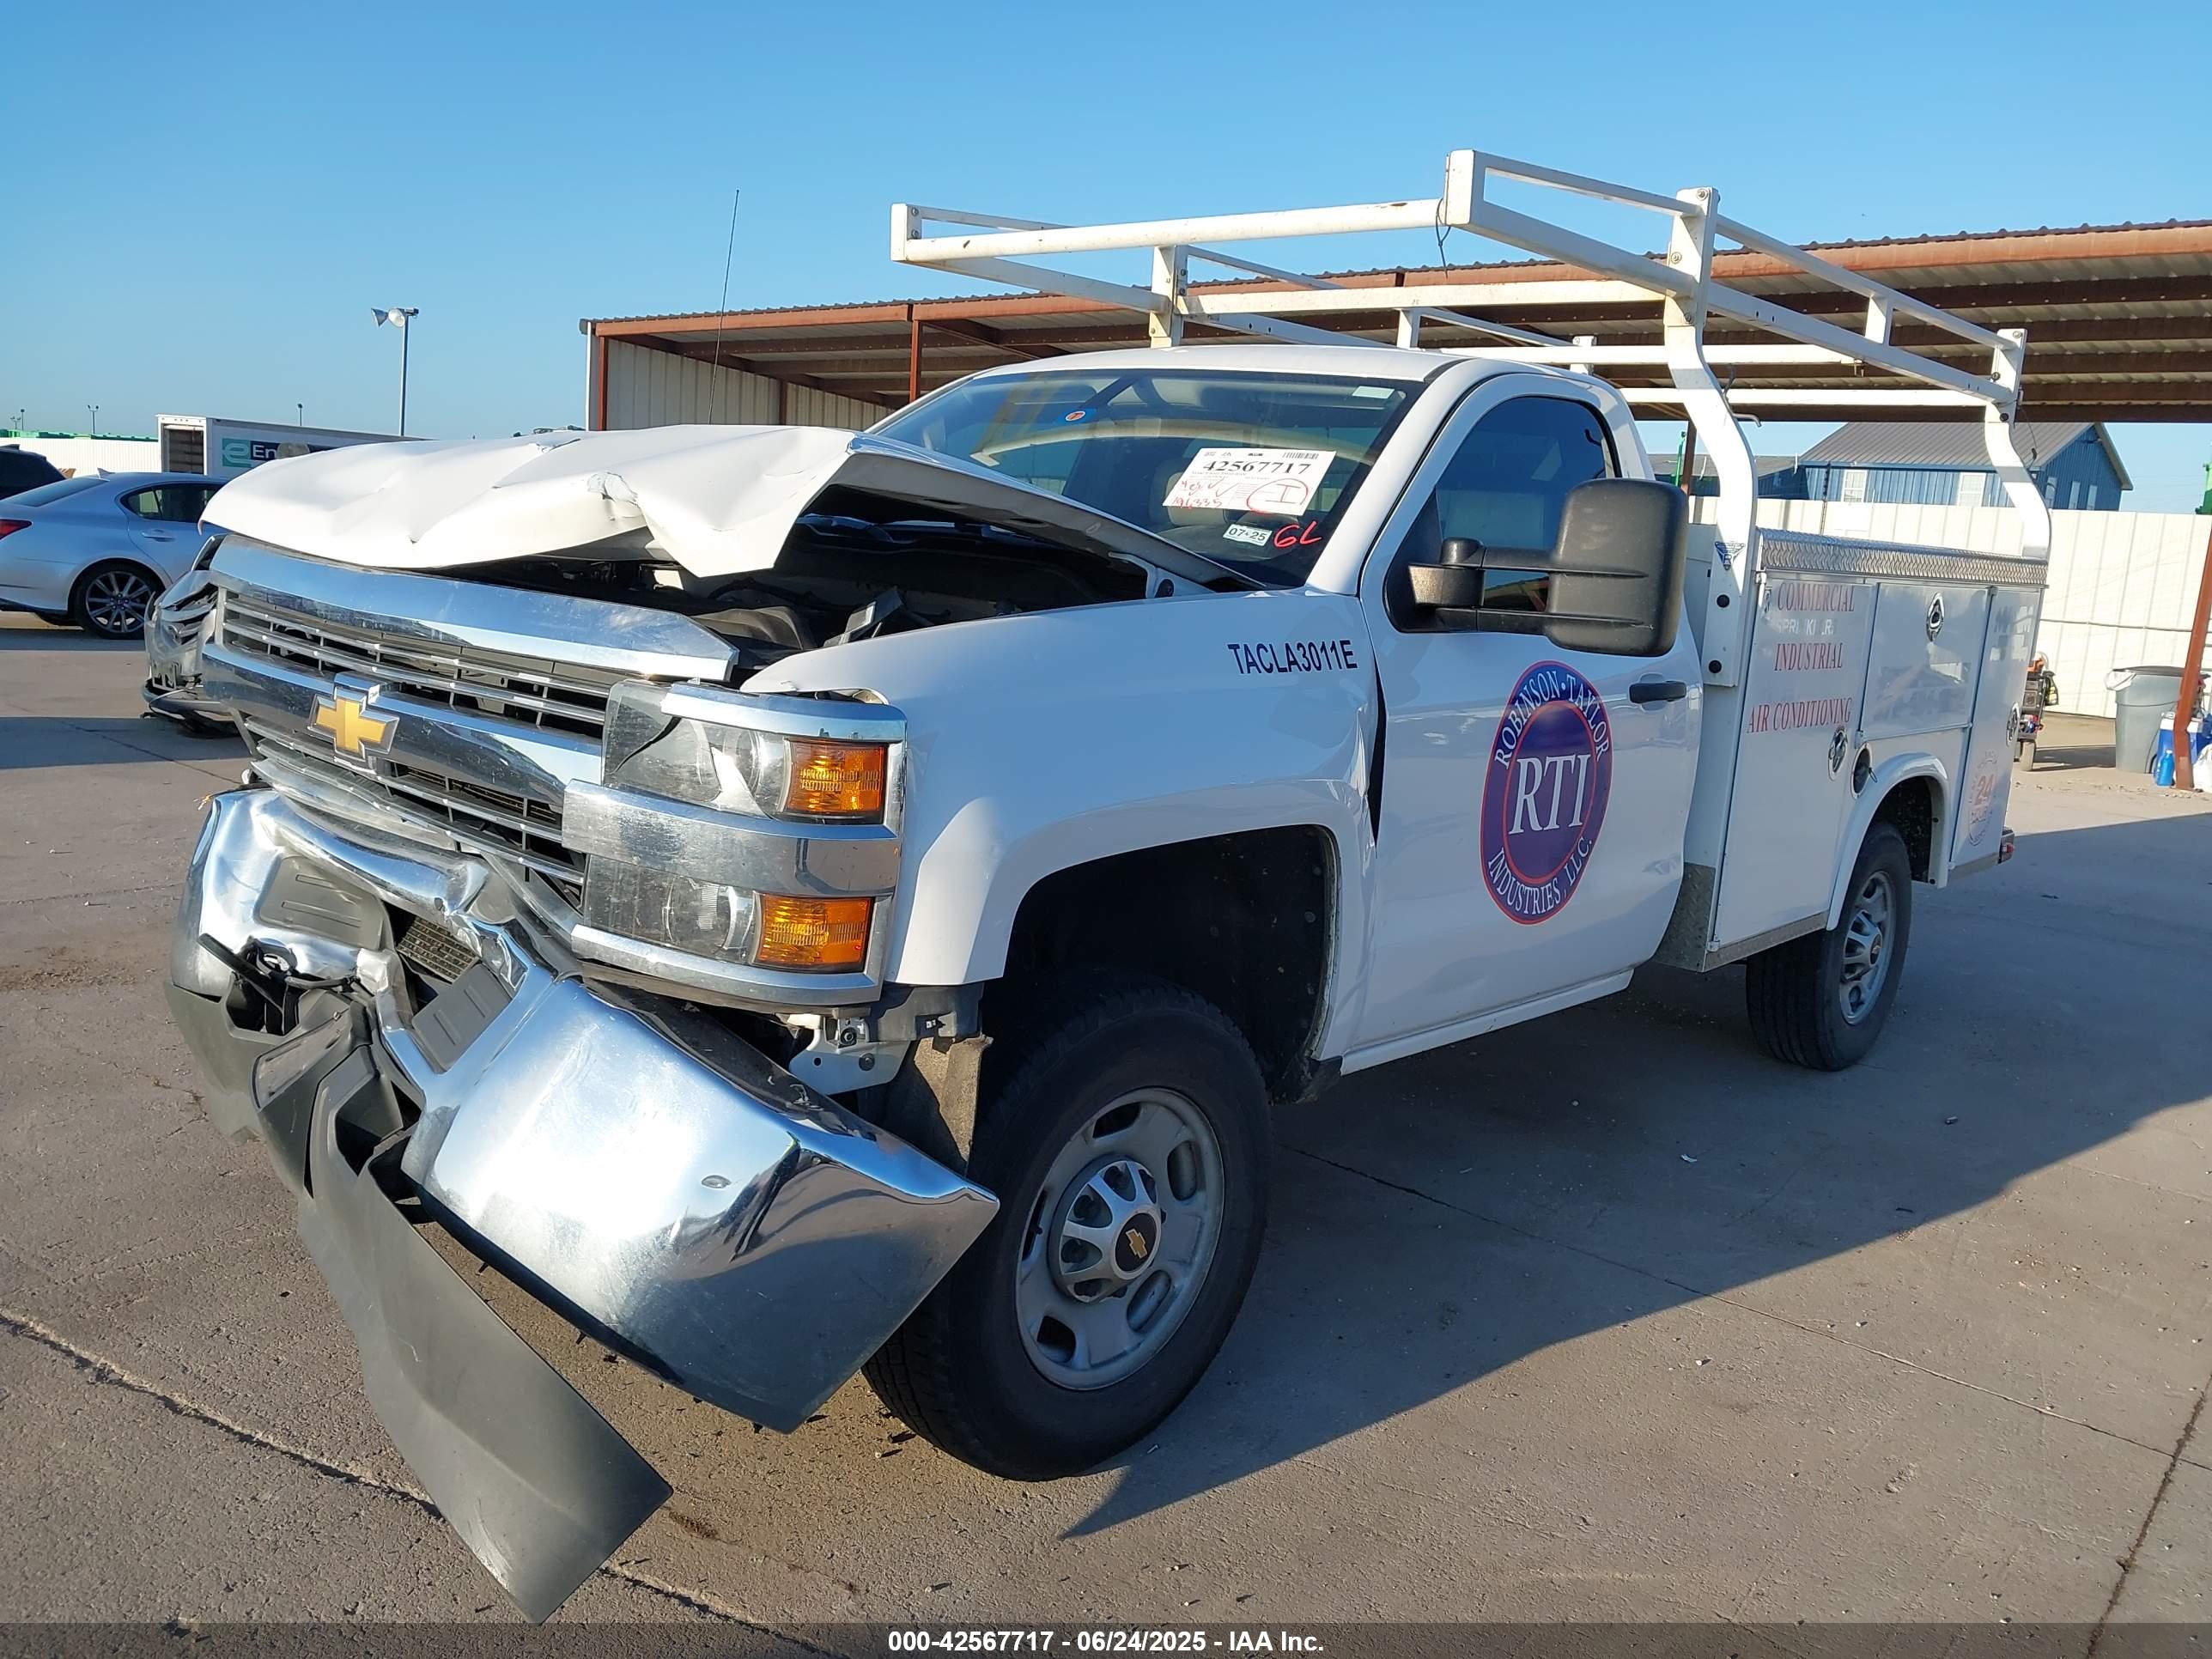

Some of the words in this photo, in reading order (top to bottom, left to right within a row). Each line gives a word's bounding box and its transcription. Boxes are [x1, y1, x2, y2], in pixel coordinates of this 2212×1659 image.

[1202, 459, 1312, 475] 42567717
[1778, 582, 1855, 612] COMMERCIAL
[1227, 640, 1358, 674] TACLA3011E
[1774, 642, 1843, 672] INDUSTRIAL
[1747, 704, 1770, 733] AIR
[1772, 697, 1852, 731] CONDITIONING
[1508, 754, 1591, 836] RTI
